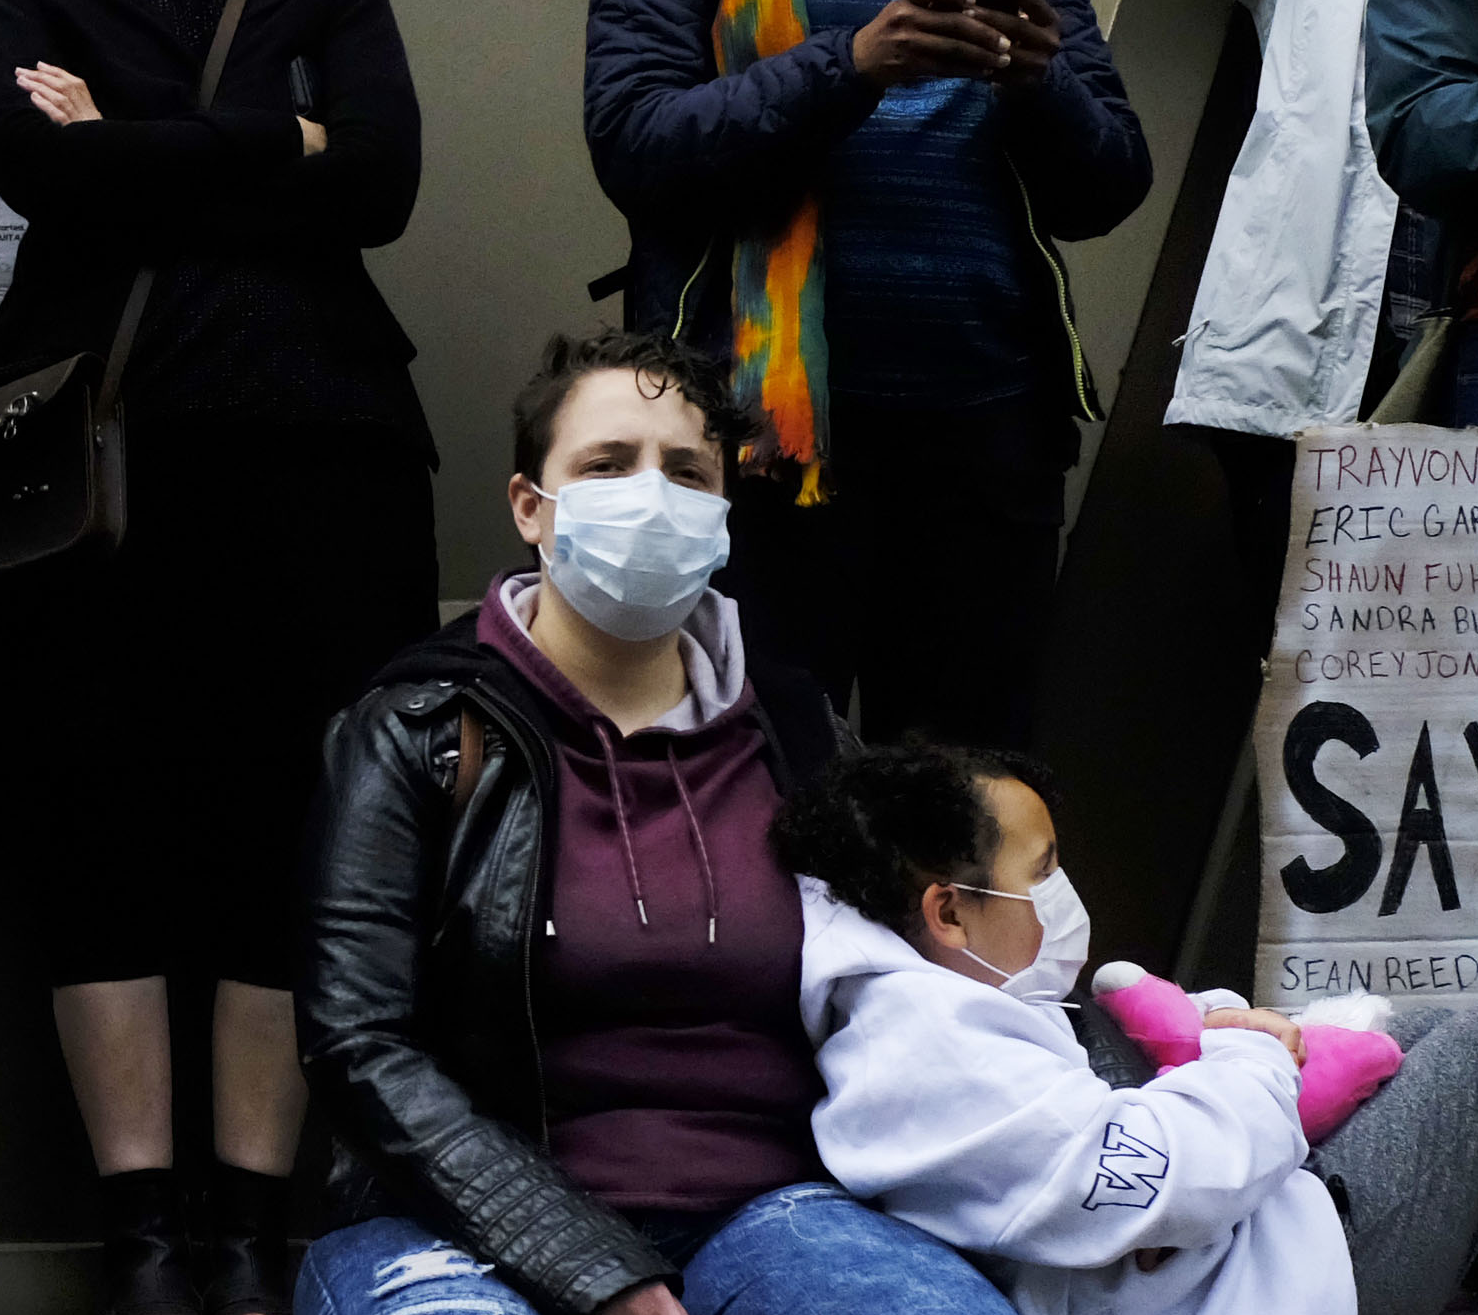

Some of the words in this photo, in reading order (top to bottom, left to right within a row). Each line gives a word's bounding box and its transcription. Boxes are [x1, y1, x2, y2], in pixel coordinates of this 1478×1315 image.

[1308, 446, 1478, 490] TRAYVON
[1306, 504, 1410, 549] ERIC
[1300, 558, 1406, 596] SHAUN
[1302, 604, 1436, 635] SANDRA
[1294, 649, 1405, 684] COREY
[1280, 956, 1372, 993] SEAN
[1081, 1122, 1169, 1210] W
